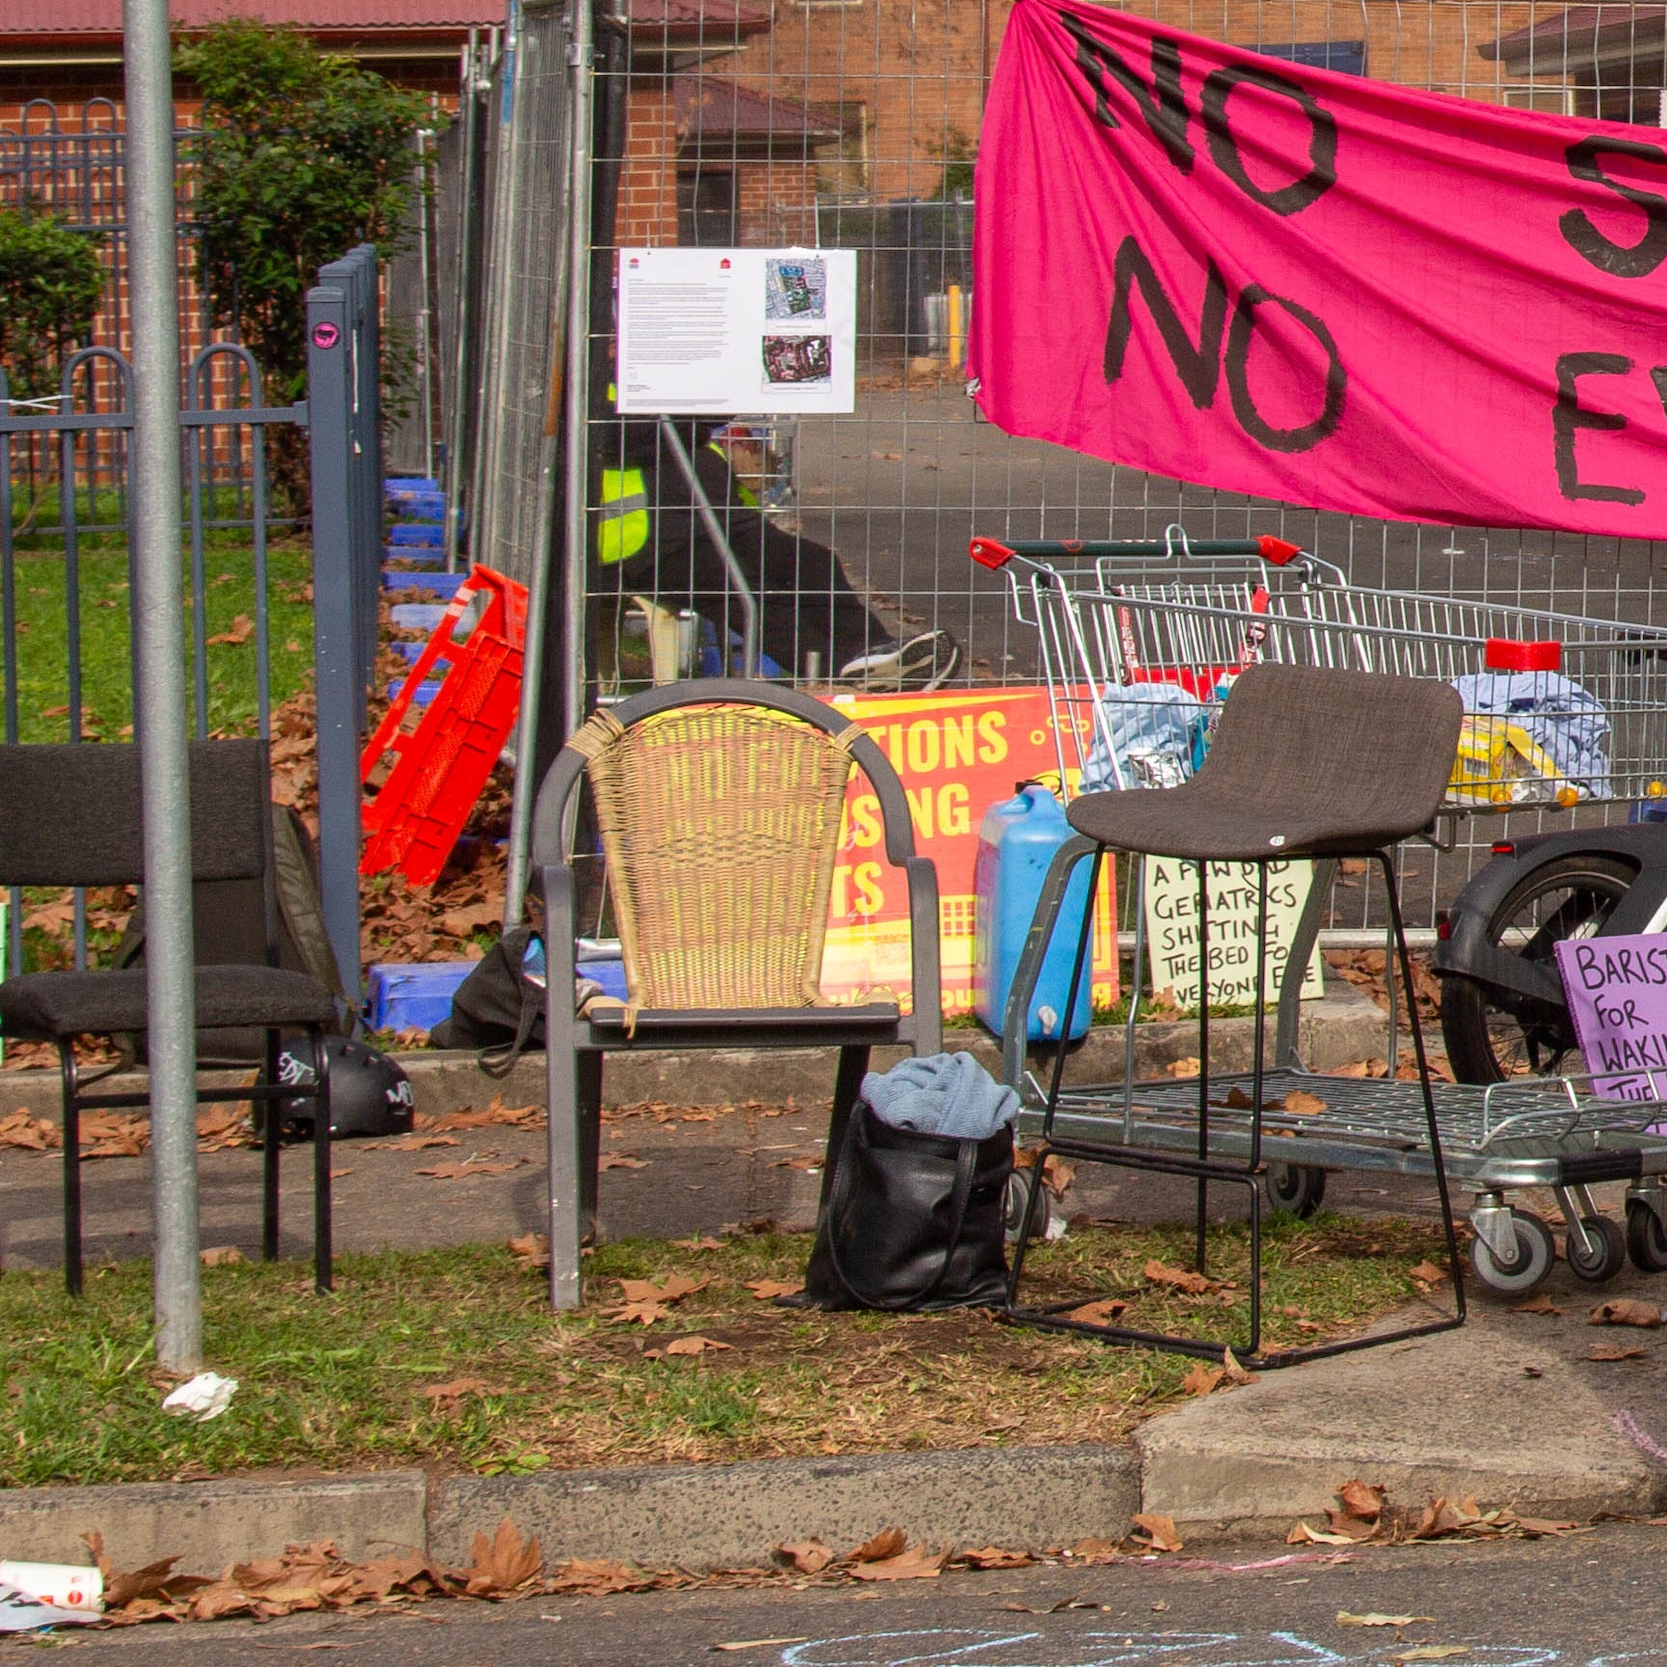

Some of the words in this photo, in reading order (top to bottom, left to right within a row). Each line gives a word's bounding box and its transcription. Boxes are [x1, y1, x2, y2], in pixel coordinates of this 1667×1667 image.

[1060, 10, 1337, 216] NO
[1104, 235, 1349, 453] NO
[866, 710, 1008, 776] TIONS
[1154, 864, 1170, 887] A
[1179, 860, 1231, 880] FW
[1162, 953, 1201, 980] THE
[1209, 946, 1249, 971] BED
[1264, 940, 1289, 962] FO
[1594, 994, 1650, 1030] FOR
